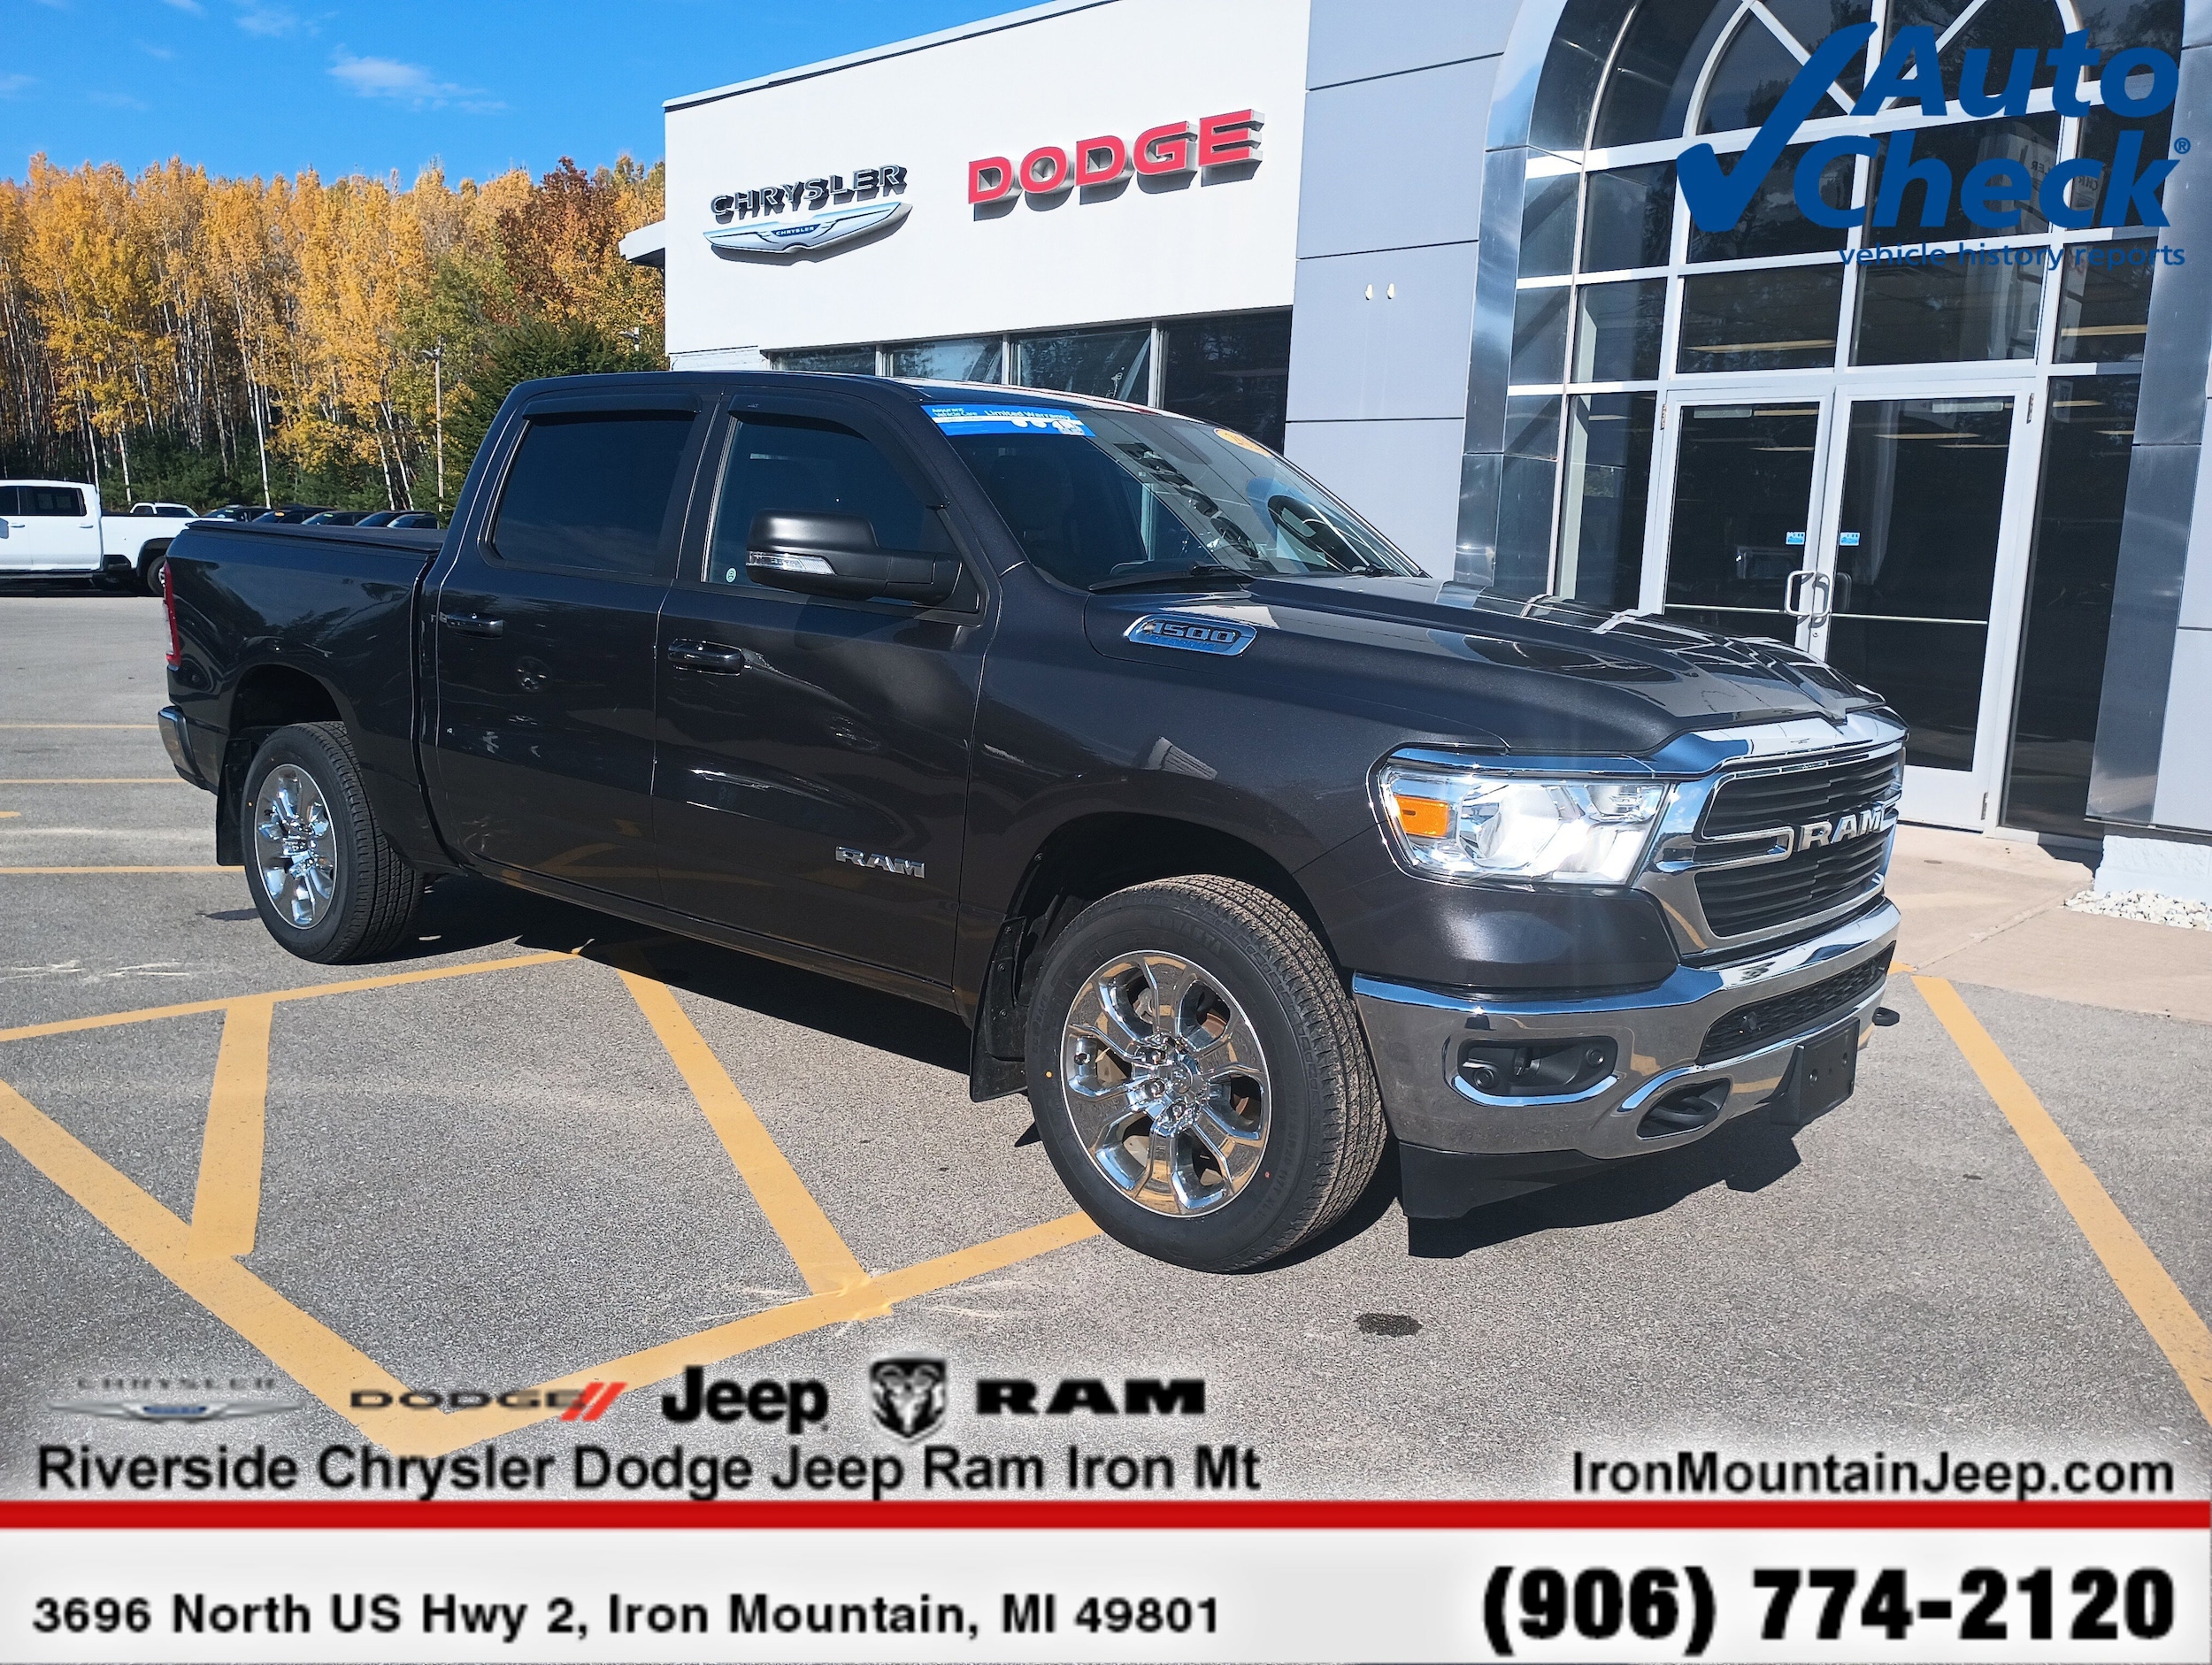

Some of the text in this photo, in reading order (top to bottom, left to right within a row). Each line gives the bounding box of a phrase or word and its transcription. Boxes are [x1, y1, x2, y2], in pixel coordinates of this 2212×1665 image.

[967, 108, 1264, 205] DODGE
[710, 163, 908, 218] CHRYSLER
[775, 226, 815, 236] CHRYSLER
[1023, 410, 1071, 419] Warranty
[1142, 620, 1237, 643] 1500
[1797, 803, 1882, 852] RAM
[835, 846, 926, 879] RAM
